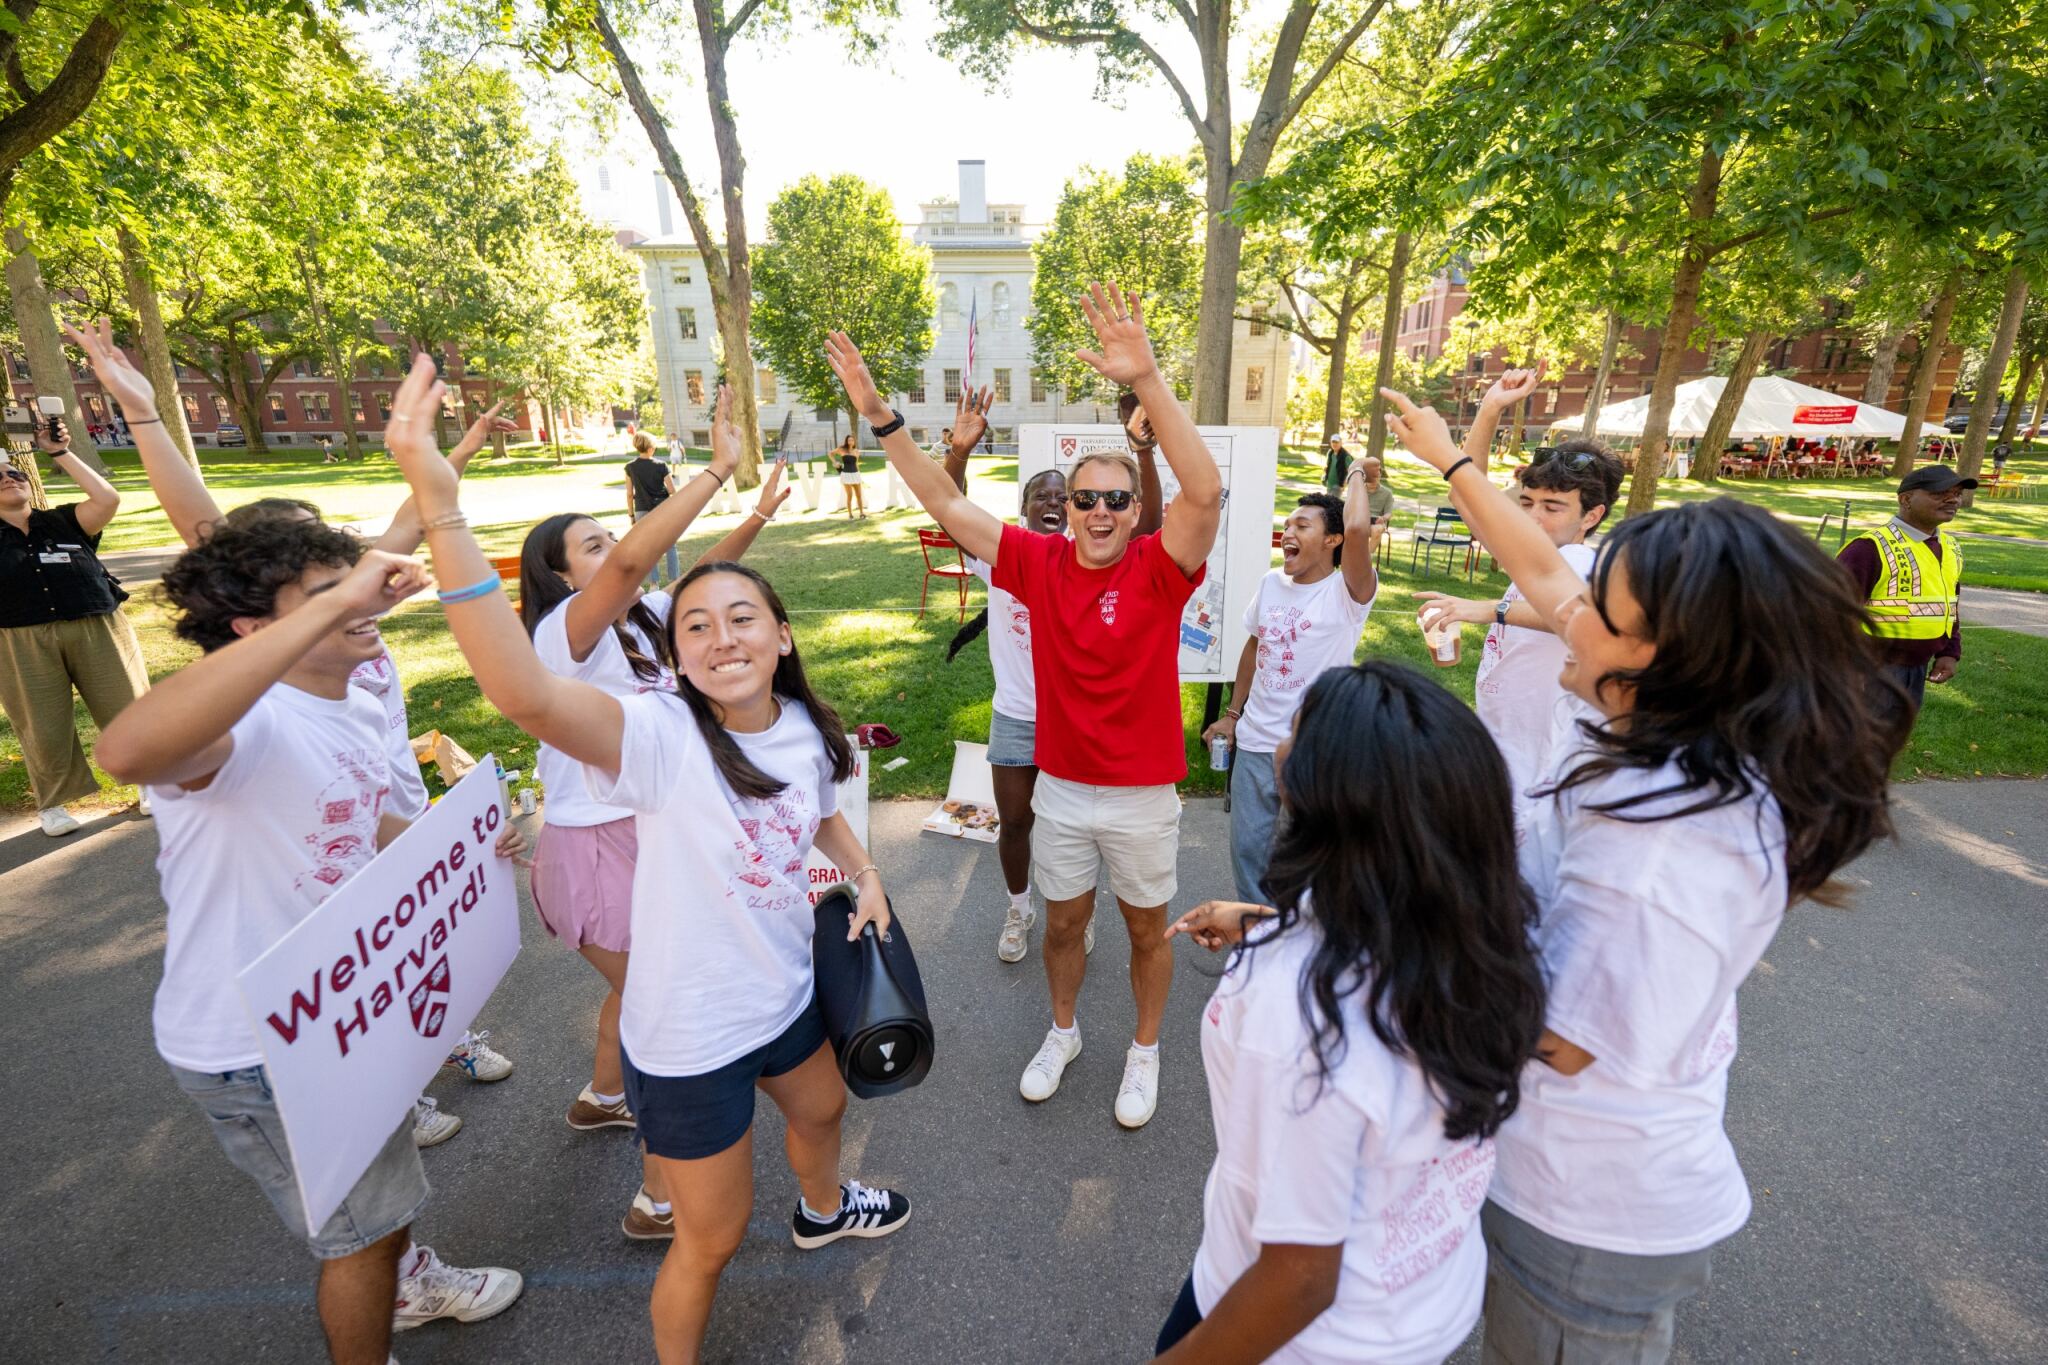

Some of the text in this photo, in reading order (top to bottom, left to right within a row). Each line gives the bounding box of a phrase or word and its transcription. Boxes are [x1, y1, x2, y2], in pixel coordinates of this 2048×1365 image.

[1889, 540, 1910, 593] PARKING
[266, 803, 500, 1045] Welcome to
[333, 862, 487, 1057] Harvard!
[746, 895, 790, 910] CLASS
